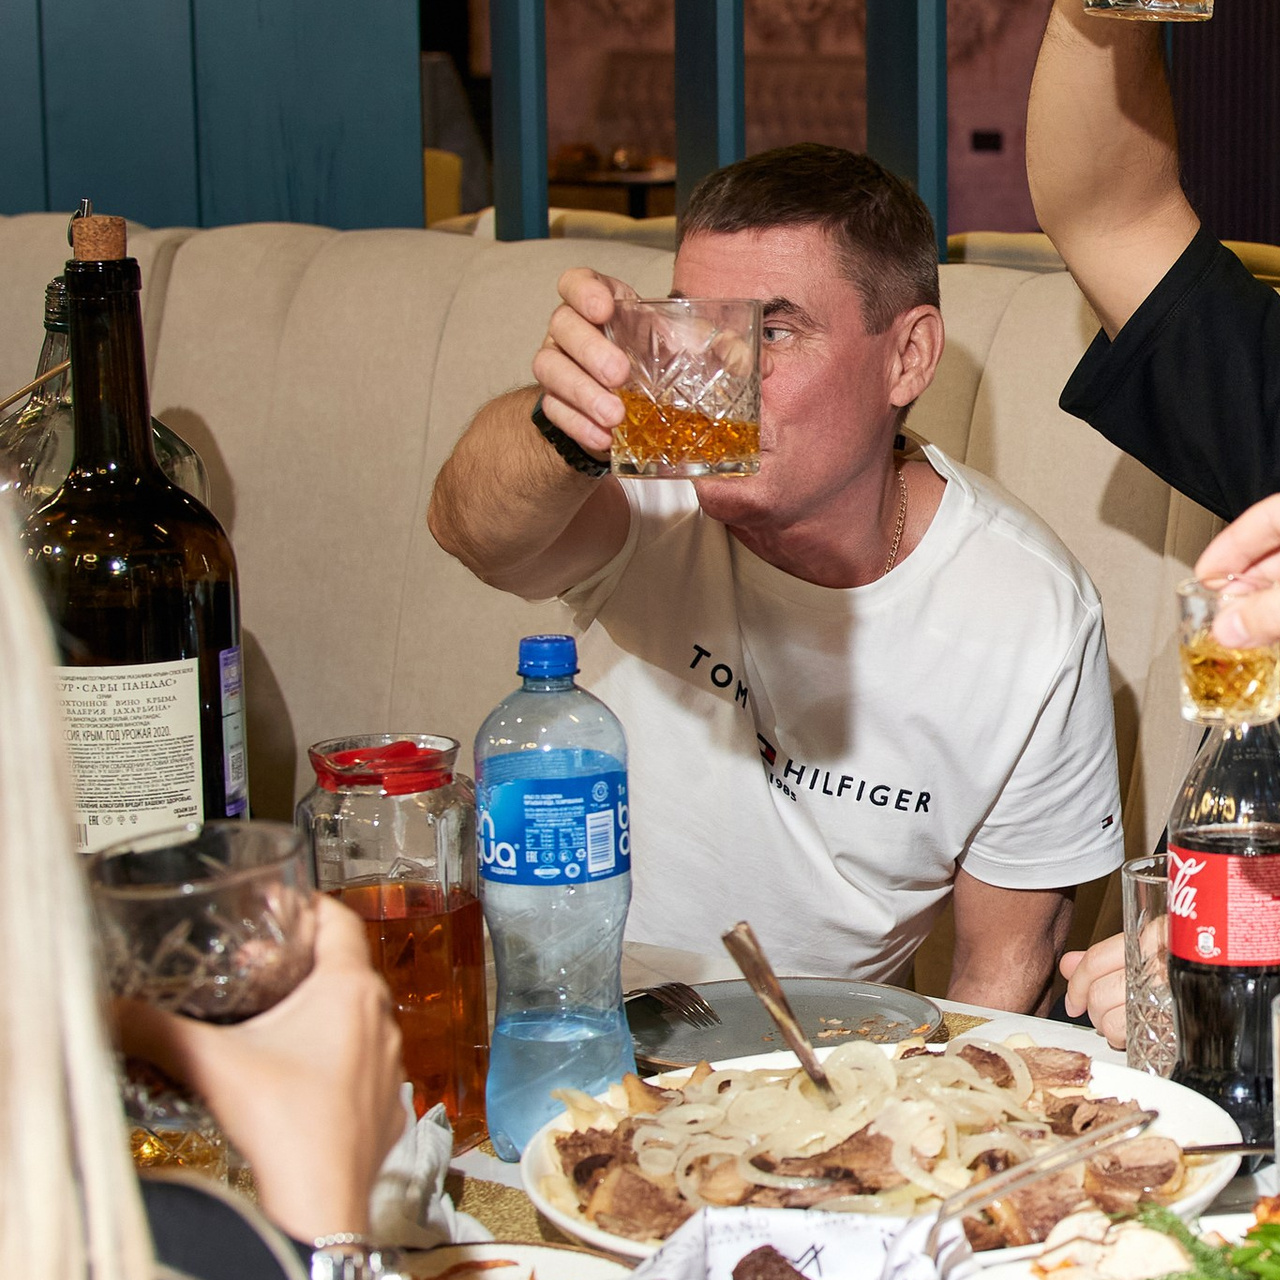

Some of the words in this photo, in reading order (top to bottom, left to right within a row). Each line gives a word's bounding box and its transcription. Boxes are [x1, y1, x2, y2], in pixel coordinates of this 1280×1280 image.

[82, 682, 118, 693] САРЫ
[689, 644, 748, 709] TOM
[146, 695, 178, 704] КРЫМА
[106, 729, 120, 742] ГОД
[121, 727, 152, 740] УРОЖАЯ
[769, 772, 797, 802] 1985
[783, 758, 932, 814] HILFIGER
